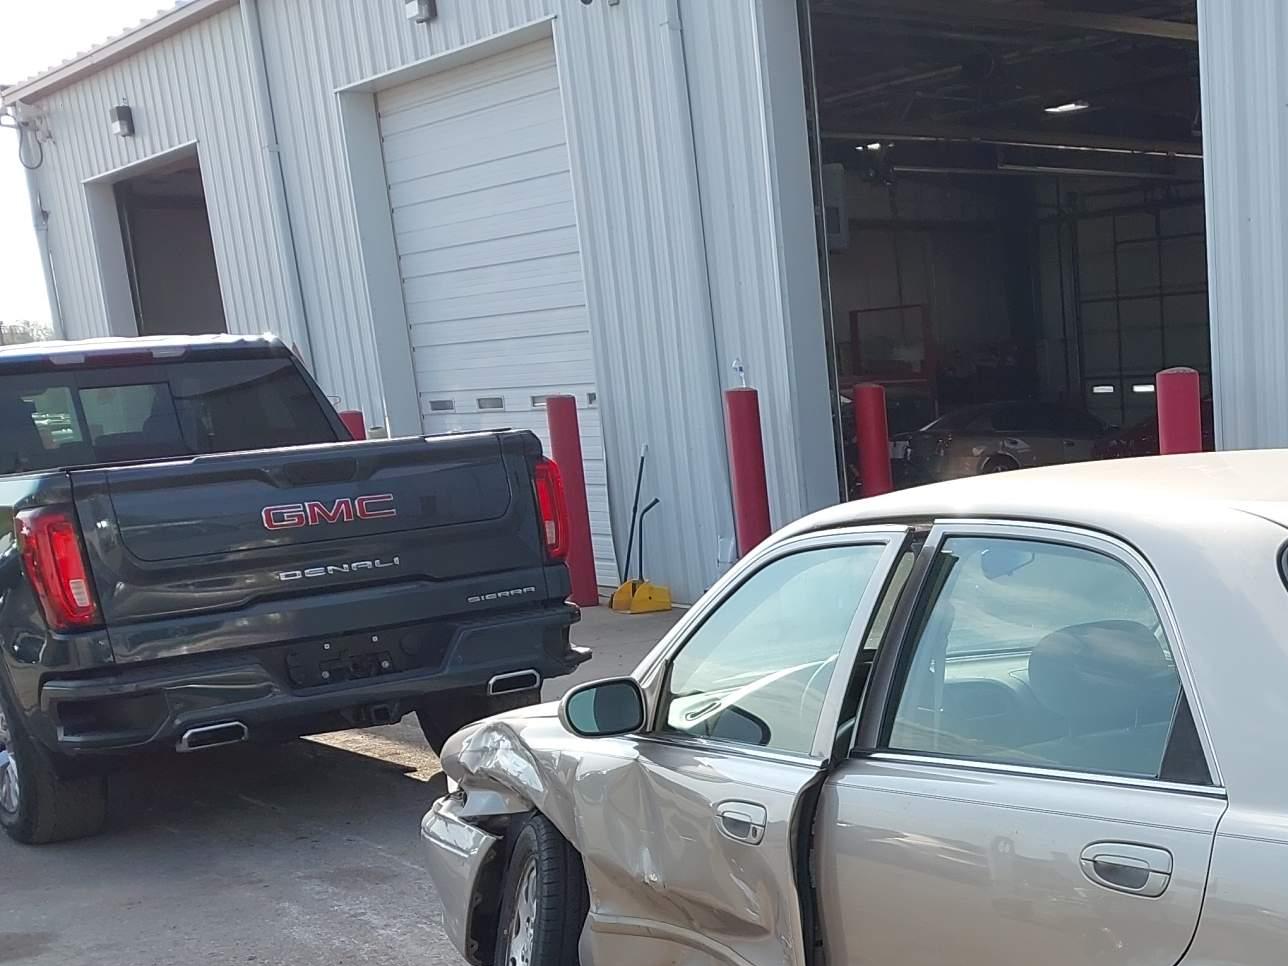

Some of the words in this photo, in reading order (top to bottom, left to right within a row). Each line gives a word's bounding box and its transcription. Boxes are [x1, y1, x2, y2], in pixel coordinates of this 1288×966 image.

[262, 493, 397, 530] GMC
[279, 556, 401, 581] DENALI
[467, 586, 536, 603] SIERRA
